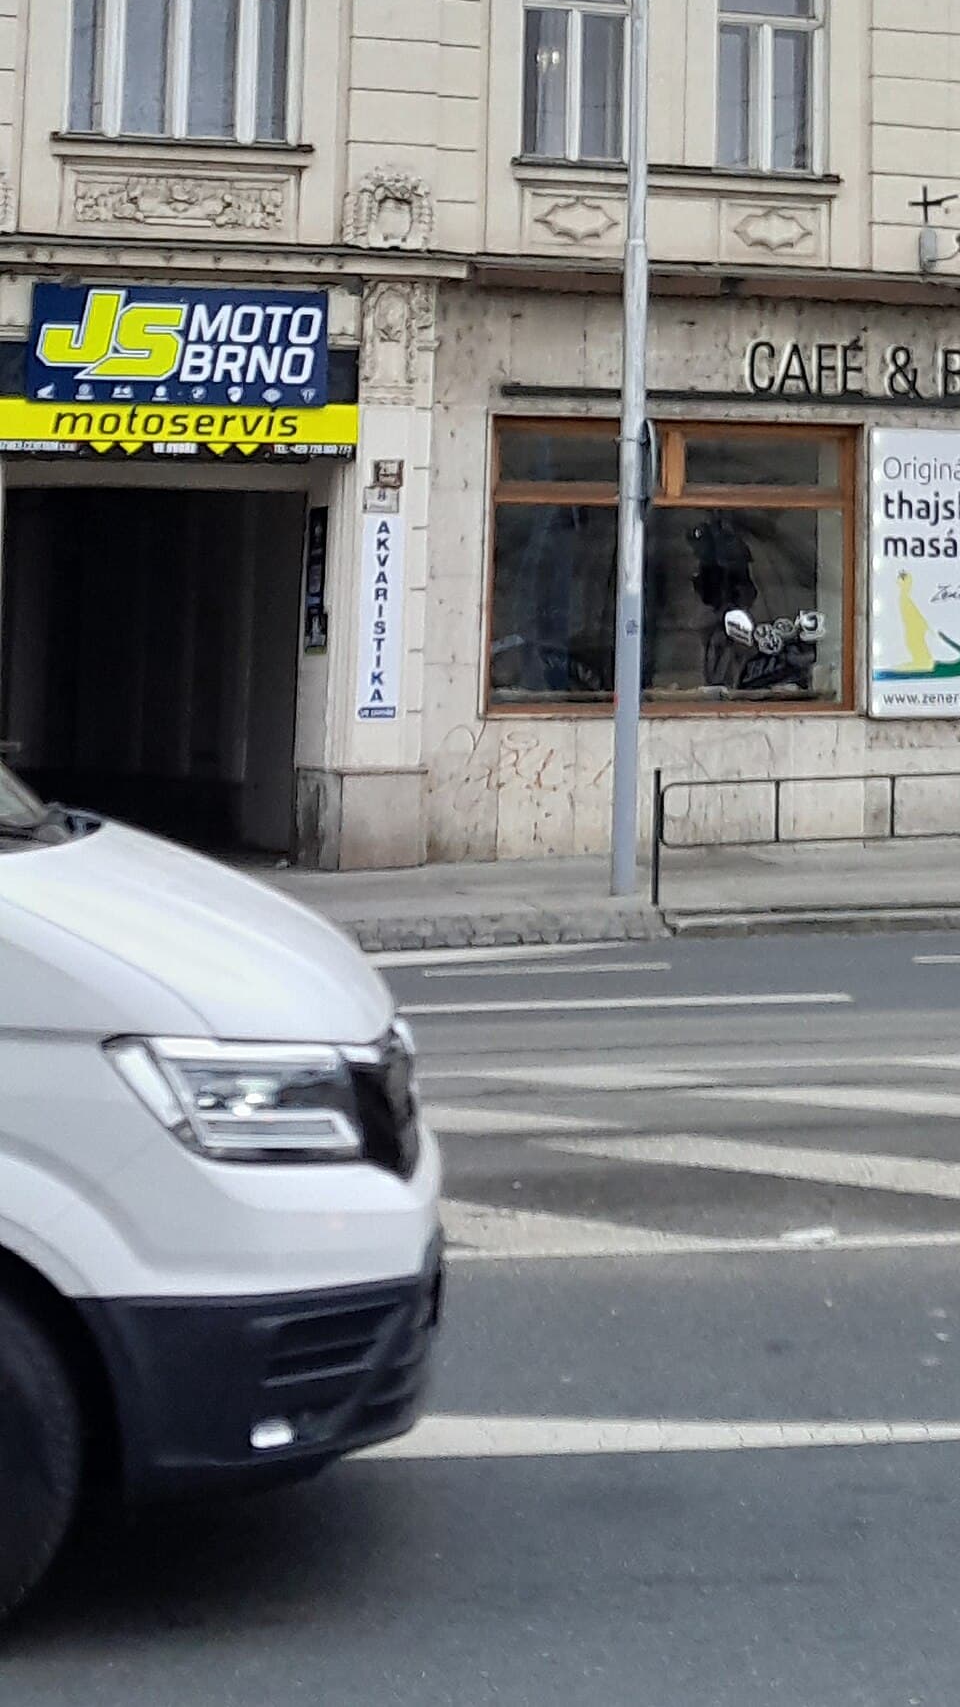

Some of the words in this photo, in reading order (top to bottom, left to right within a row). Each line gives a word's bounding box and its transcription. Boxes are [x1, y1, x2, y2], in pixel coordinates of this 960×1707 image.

[36, 289, 188, 381] JS
[188, 304, 322, 345] MOTO
[179, 344, 314, 384] BRNO
[744, 334, 864, 394] CAFÉ
[885, 345, 923, 400] &
[52, 404, 298, 436] motoservis
[369, 520, 390, 703] AKVARISTIKA
